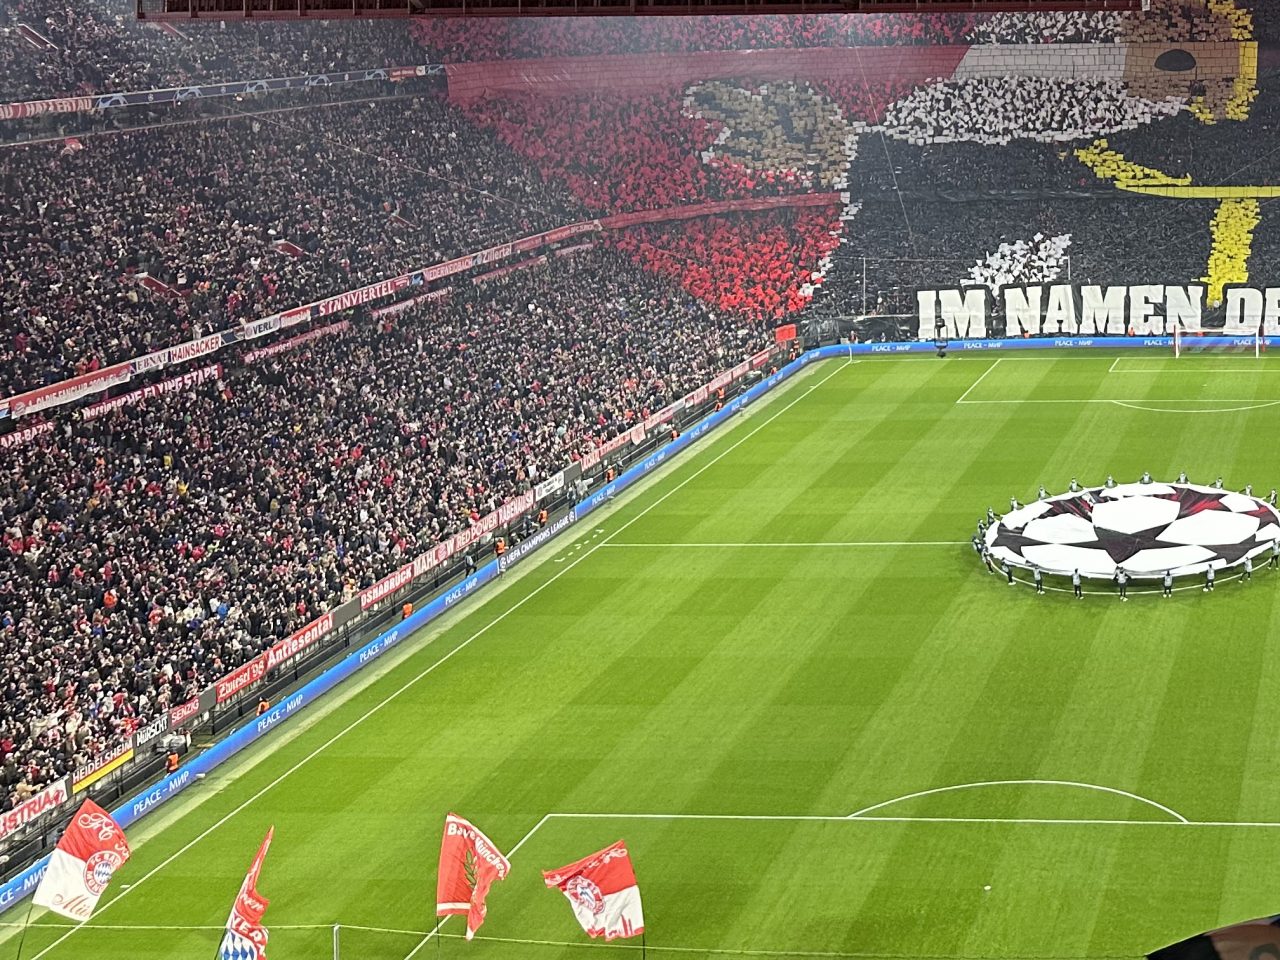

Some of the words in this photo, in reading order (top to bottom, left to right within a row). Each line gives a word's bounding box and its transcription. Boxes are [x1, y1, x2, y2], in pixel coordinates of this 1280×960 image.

[482, 243, 512, 264] Zillertal
[917, 290, 986, 339] IM
[1004, 285, 1204, 338] NAMEN
[252, 321, 273, 335] VERL
[171, 336, 220, 361] HAINSACKER
[456, 532, 471, 550] RED
[471, 515, 498, 540] POWER
[506, 550, 521, 564] UEFA
[521, 528, 551, 554] CHAMPIONS
[550, 515, 569, 535] LEAGUE
[361, 567, 413, 608] OSNABRÜCK
[445, 583, 462, 605] PEACE
[266, 613, 334, 669] Antiesental
[359, 643, 380, 663] PEACE
[218, 669, 251, 698] Zwiesel
[170, 698, 200, 720] SENZIG
[257, 709, 281, 732] PEACE
[72, 736, 133, 784] HEIDELSHEIM
[168, 771, 190, 792] МИР
[133, 790, 162, 816] PEACE
[91, 855, 100, 866] FC
